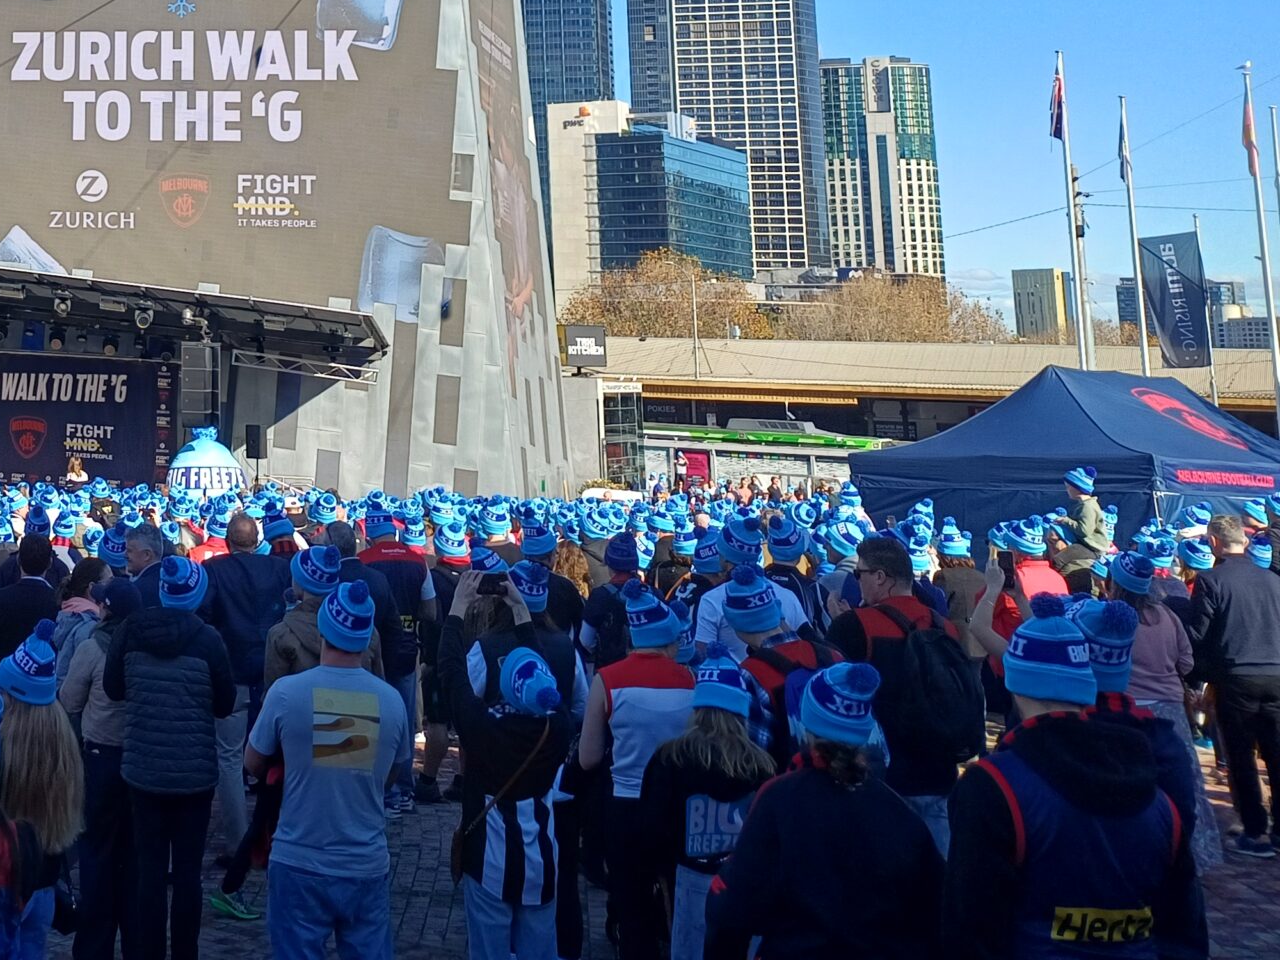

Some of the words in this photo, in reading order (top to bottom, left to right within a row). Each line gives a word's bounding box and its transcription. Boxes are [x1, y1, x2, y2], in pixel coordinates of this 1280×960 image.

[10, 30, 195, 81] ZURICH
[206, 29, 359, 81] WALK
[63, 90, 133, 141] TO
[140, 90, 242, 141] THE
[563, 119, 584, 129] pwc
[237, 174, 317, 195] FIGHT
[48, 211, 135, 230] ZURICH
[237, 219, 248, 227] IT
[250, 219, 280, 228] TAKES
[281, 219, 317, 228] PEOPLE
[1, 373, 50, 401] WALK
[51, 373, 73, 401] TO
[75, 374, 109, 402] THE
[66, 424, 114, 439] FIGHT
[729, 539, 757, 555] XII
[303, 559, 331, 584] XII
[519, 579, 544, 595] XII
[329, 598, 356, 628] XII
[1056, 912, 1152, 941] Hertz
